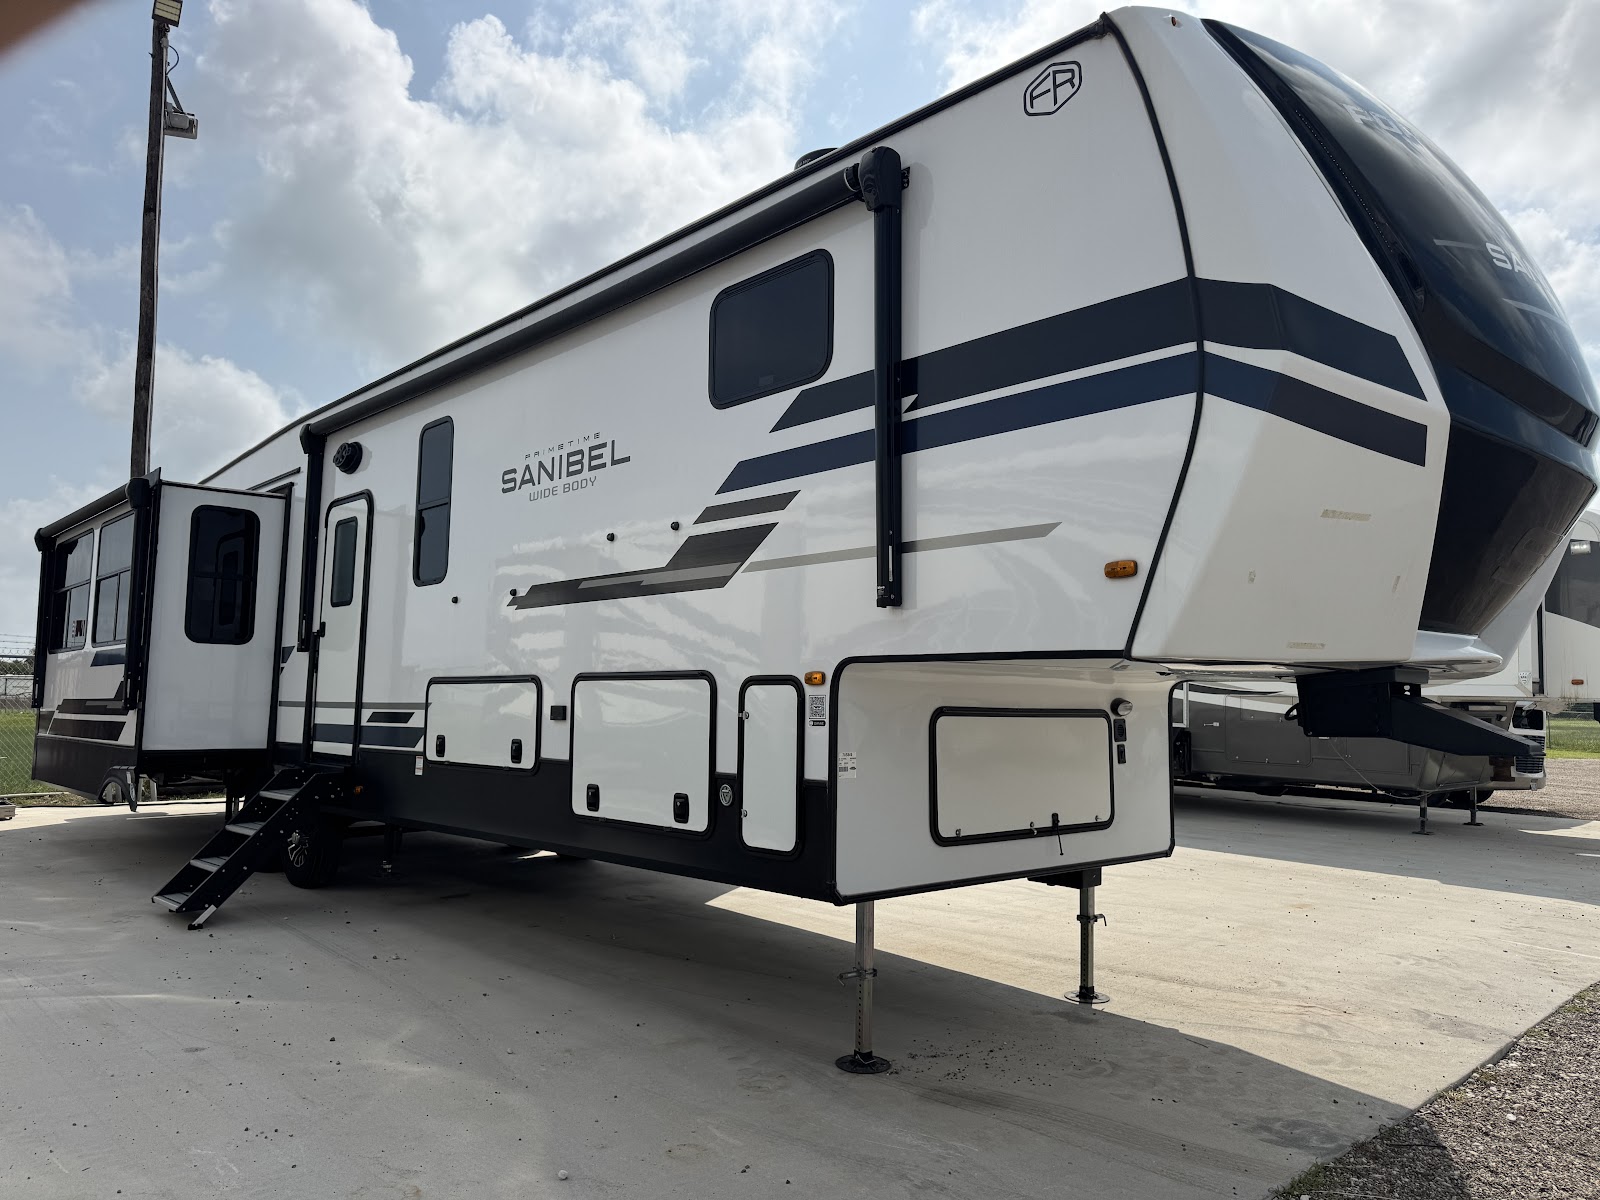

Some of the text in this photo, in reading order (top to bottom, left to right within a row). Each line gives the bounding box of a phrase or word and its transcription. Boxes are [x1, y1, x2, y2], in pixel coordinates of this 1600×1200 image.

[524, 431, 601, 461] PRIMETIME
[501, 439, 631, 494] SANIBEL
[529, 475, 597, 502] WIDE BODY
